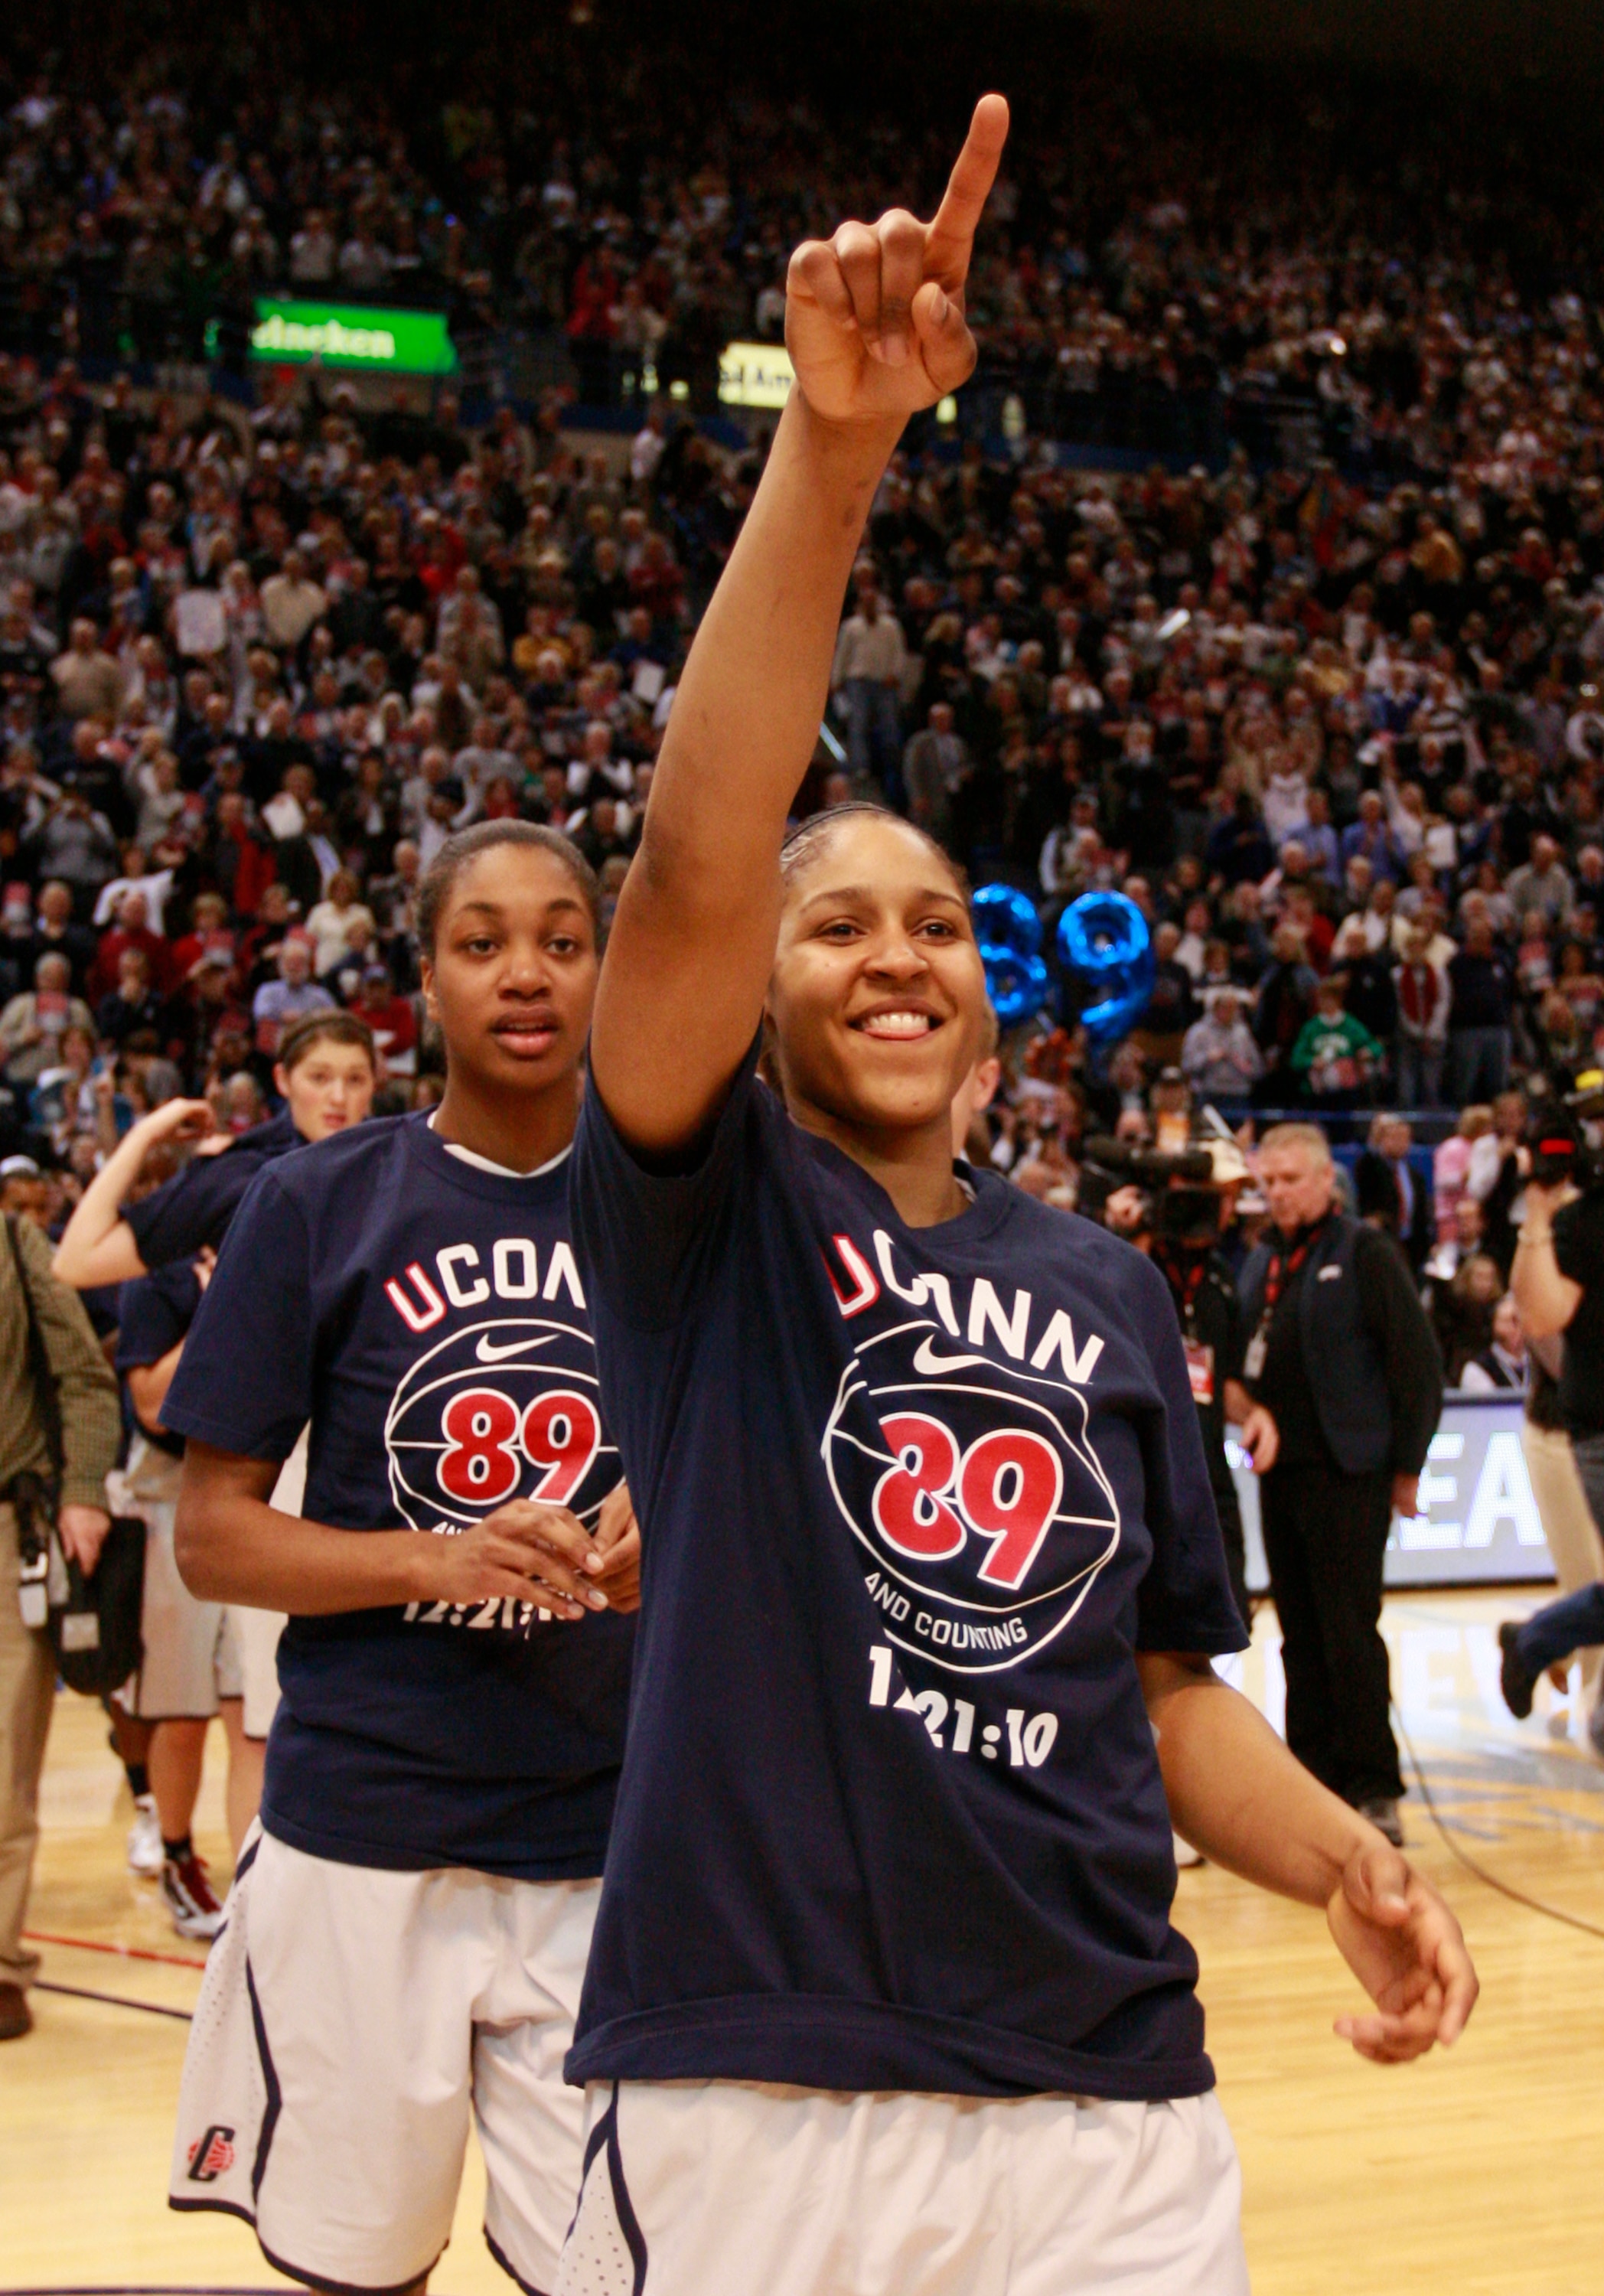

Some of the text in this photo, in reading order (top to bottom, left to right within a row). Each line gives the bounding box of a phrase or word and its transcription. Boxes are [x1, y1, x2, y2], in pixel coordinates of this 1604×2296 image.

[973, 882, 1155, 1042] 89
[384, 1238, 587, 1333] UCON
[436, 1387, 602, 1507] 89
[871, 1411, 1064, 1591] 89
[864, 1572, 1029, 1651] AND COUNTING
